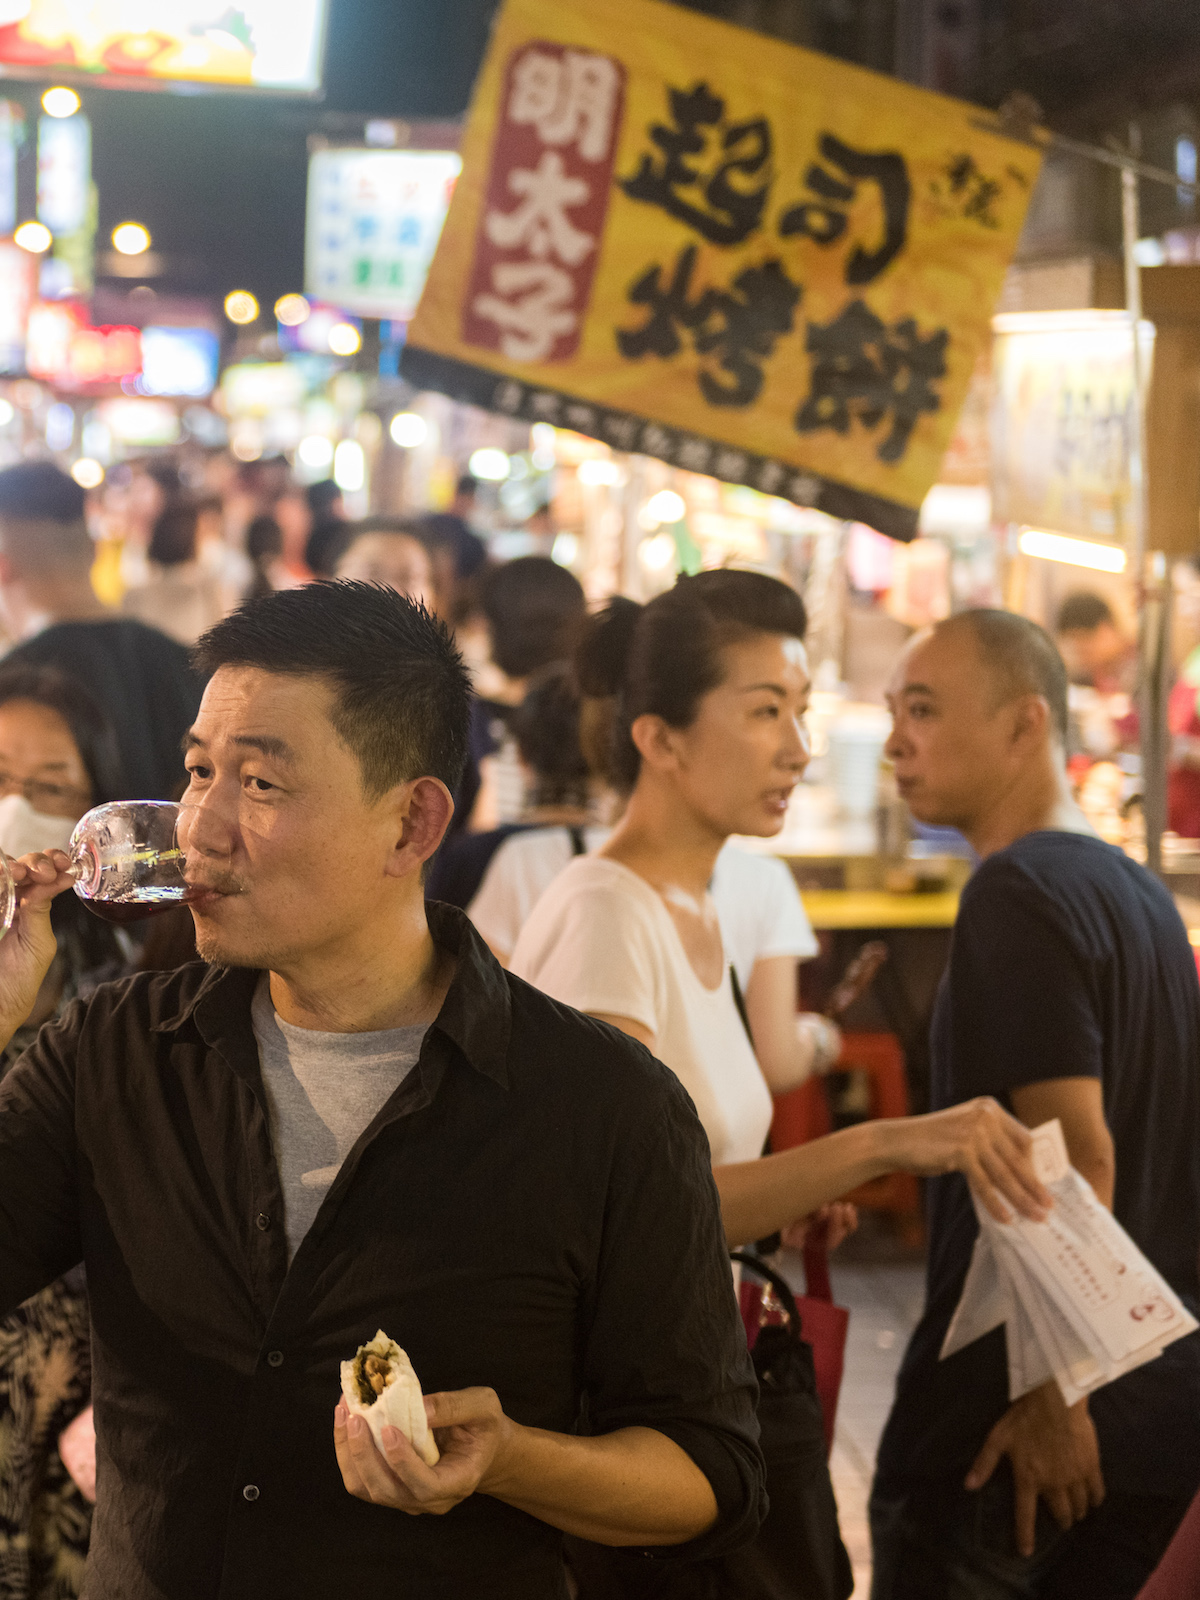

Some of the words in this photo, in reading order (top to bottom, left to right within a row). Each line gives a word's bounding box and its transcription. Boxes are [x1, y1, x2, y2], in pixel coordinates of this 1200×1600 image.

[473, 50, 620, 363] 明太子
[618, 82, 913, 287] 起司
[614, 245, 950, 468] 烤餅
